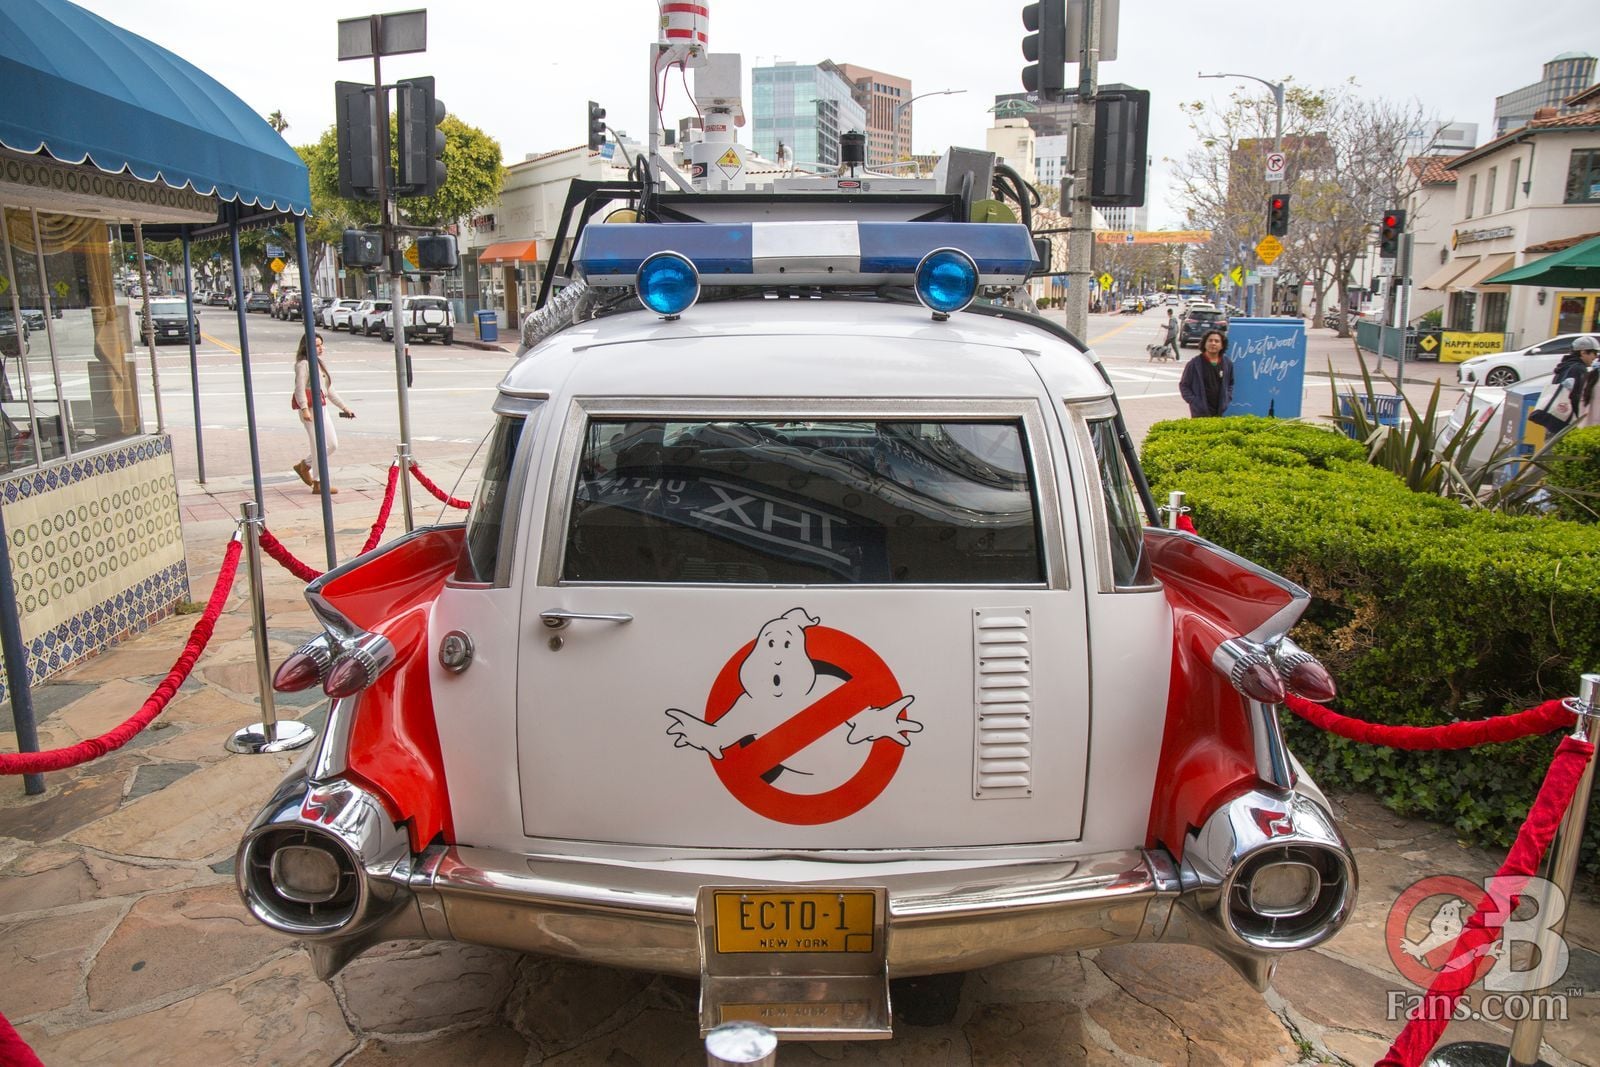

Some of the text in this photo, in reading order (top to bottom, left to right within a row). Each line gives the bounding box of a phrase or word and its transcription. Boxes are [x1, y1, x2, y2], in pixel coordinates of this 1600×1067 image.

[1231, 329, 1299, 363] Westwood
[1444, 340, 1501, 349] HAPPY HOURS
[1252, 355, 1300, 382] Village
[739, 900, 849, 931] ECTO-1
[760, 938, 829, 948] NEW YORK
